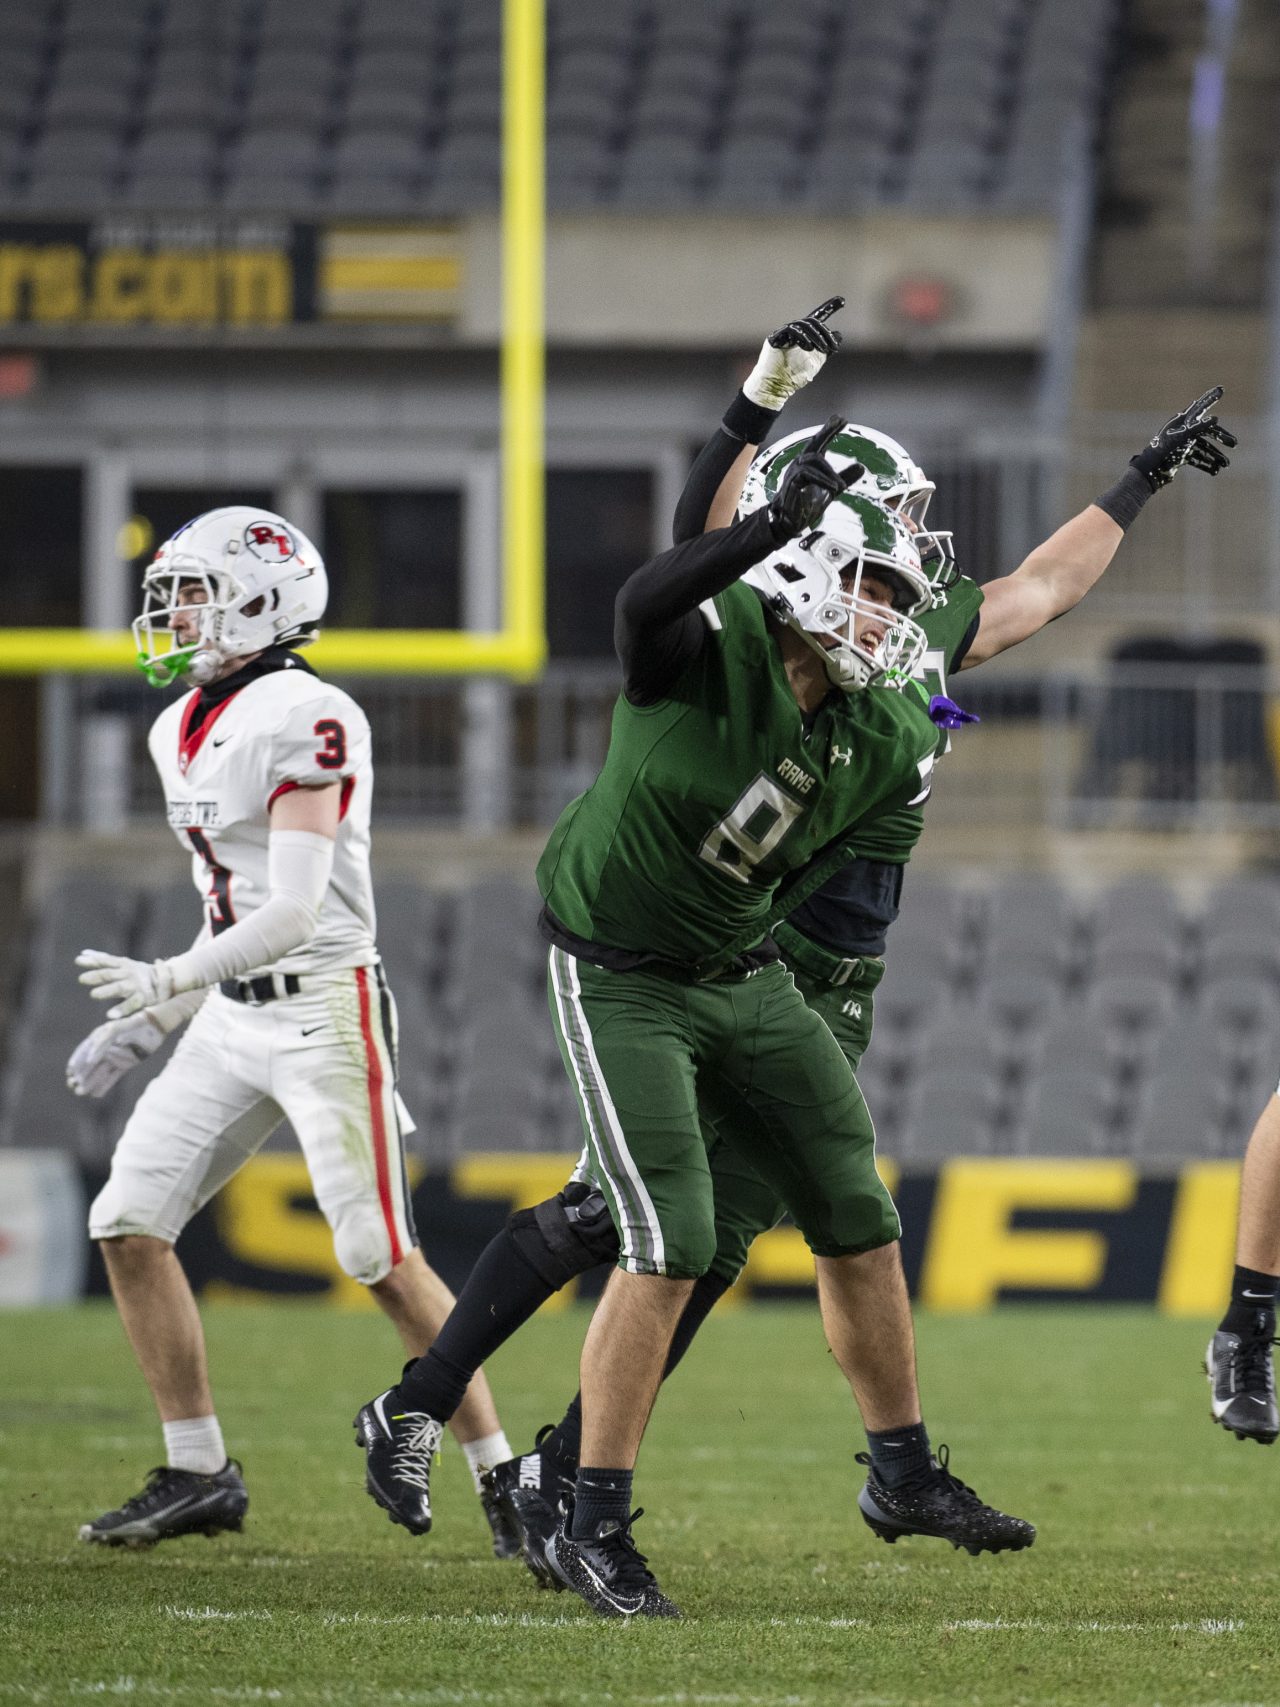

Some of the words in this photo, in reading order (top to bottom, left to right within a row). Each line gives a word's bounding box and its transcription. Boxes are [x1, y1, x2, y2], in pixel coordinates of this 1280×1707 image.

[313, 718, 347, 770] 3
[777, 757, 816, 794] RAMS
[519, 1453, 541, 1489] NIKE
